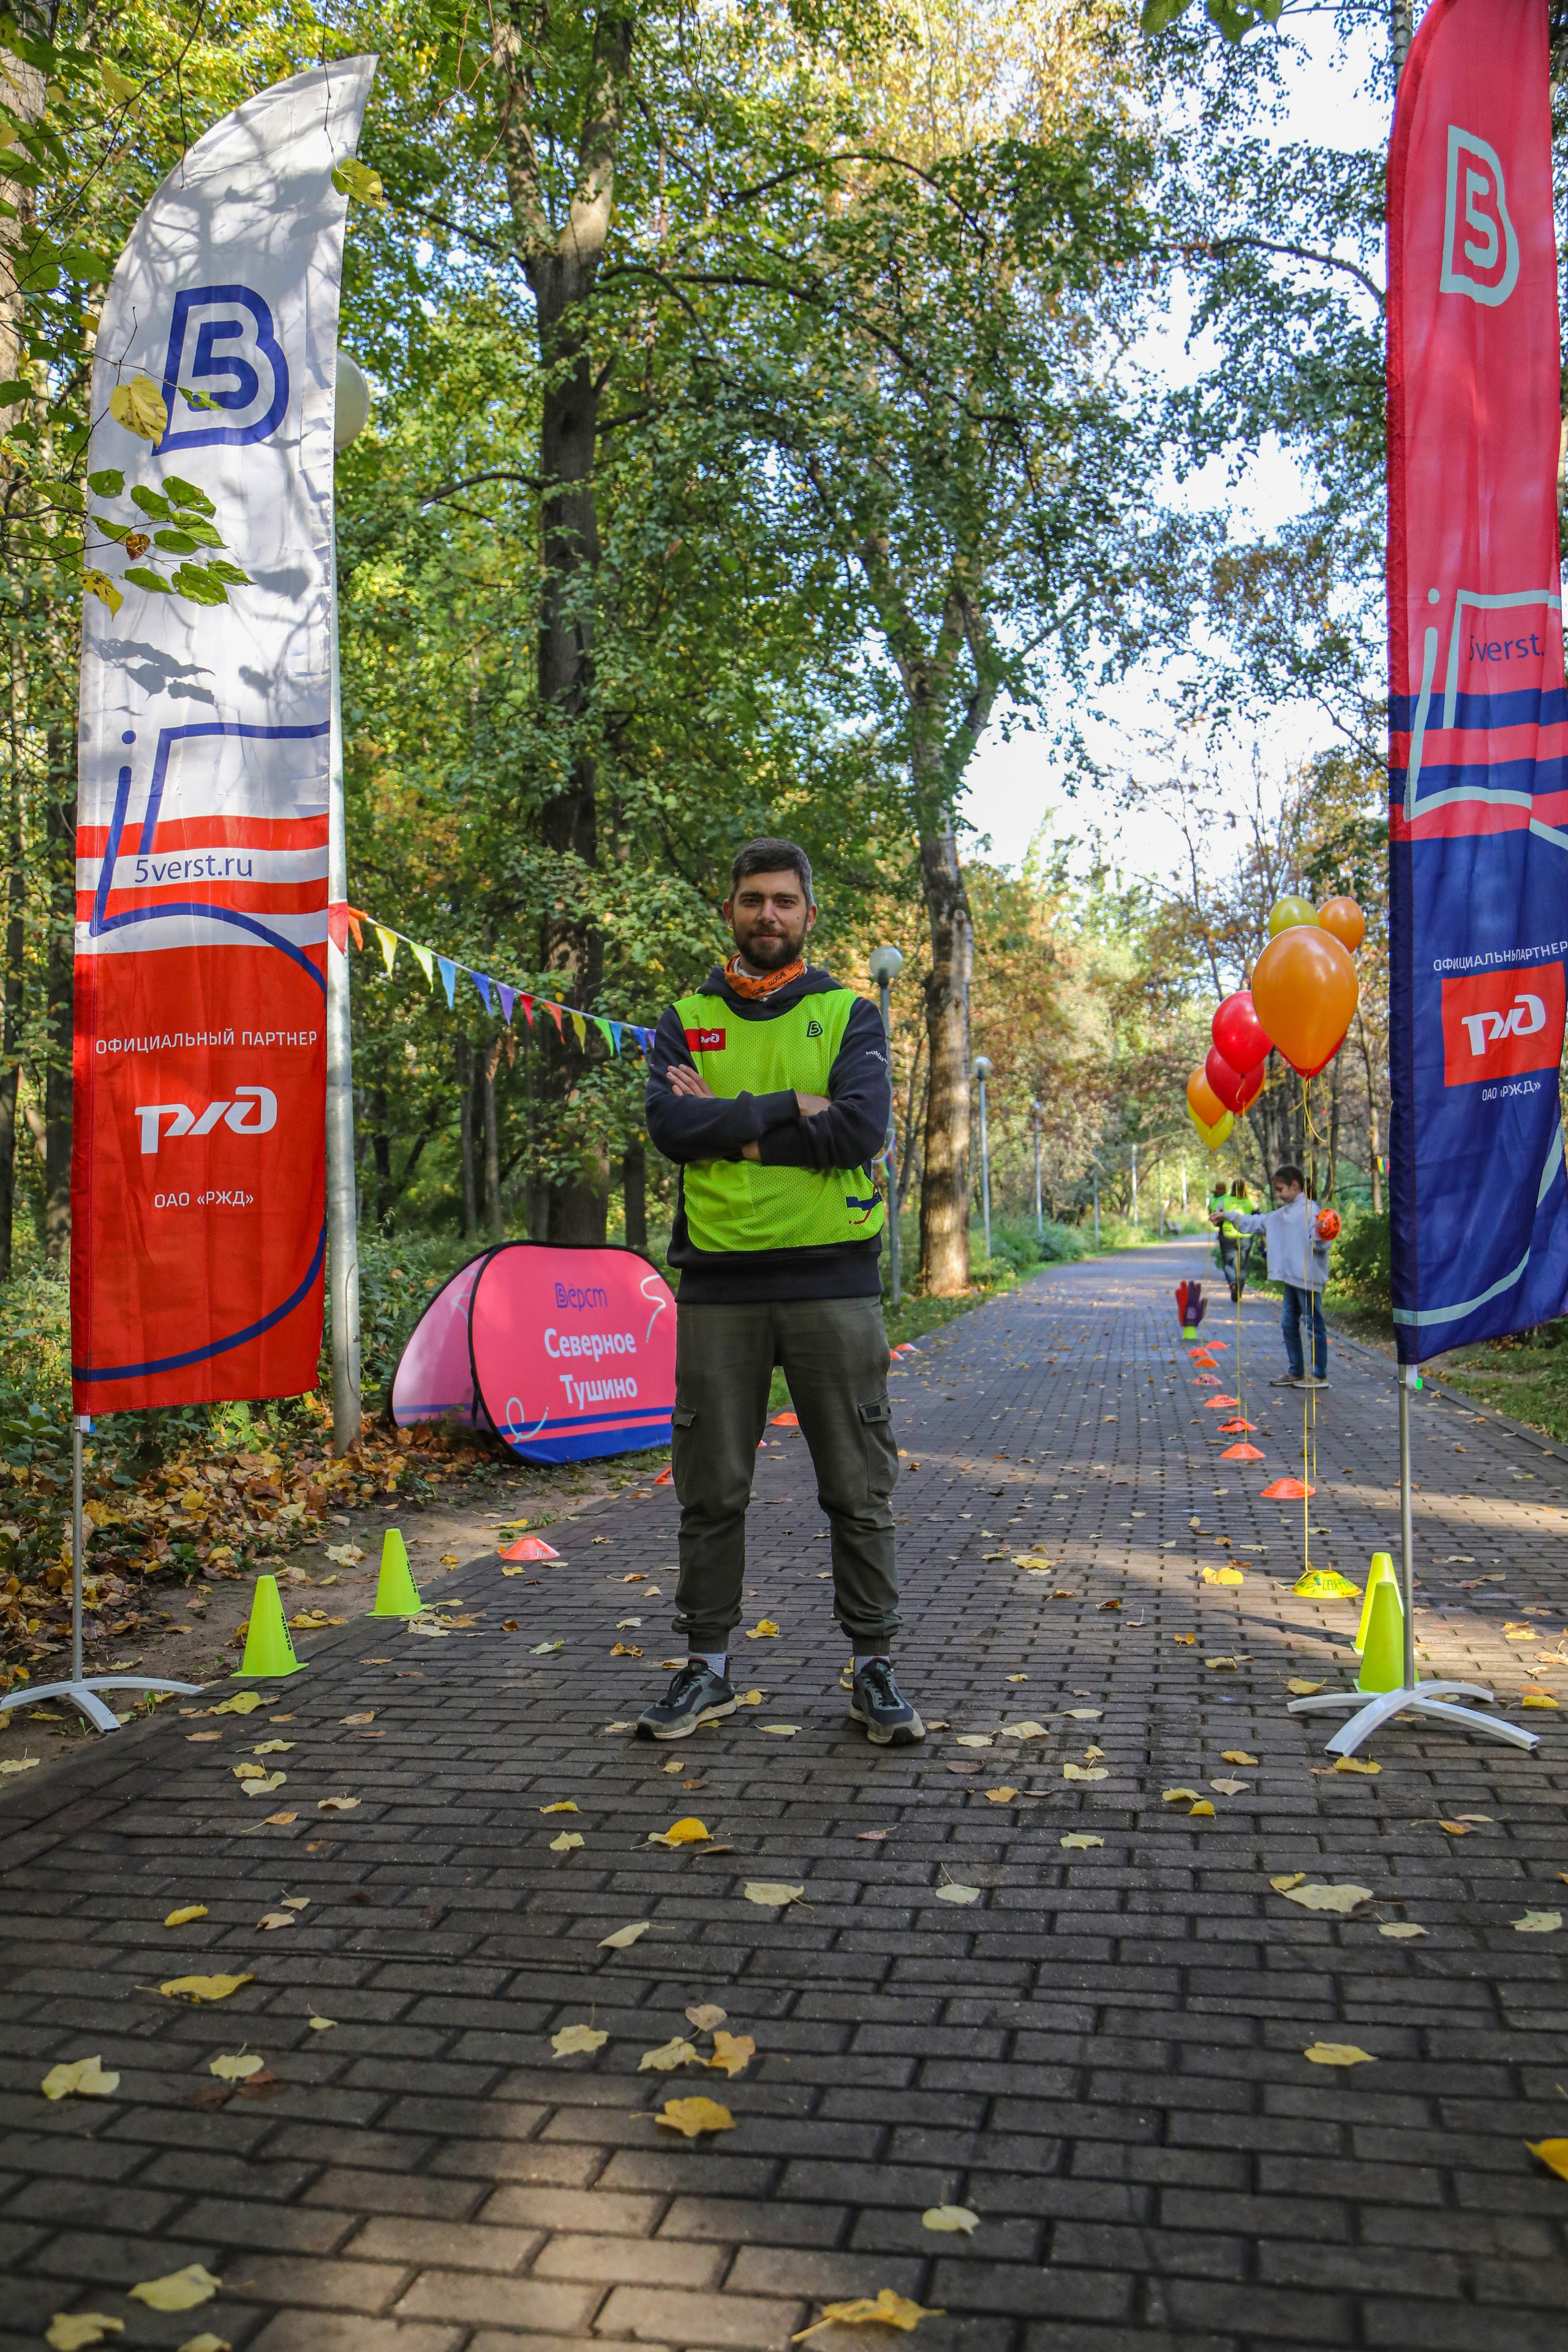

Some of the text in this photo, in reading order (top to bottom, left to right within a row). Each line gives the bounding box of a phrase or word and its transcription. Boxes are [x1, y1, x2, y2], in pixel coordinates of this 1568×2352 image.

[135, 854, 252, 883] 5verst.ru
[96, 1028, 317, 1054] ОФИЦИАЛЬНЫЙ ПАРТНЕР
[1482, 1087, 1497, 1101] ОАО
[154, 1191, 254, 1208] ОАО «РЖД»
[544, 1327, 636, 1362] Северное
[559, 1374, 638, 1410] Тушино
